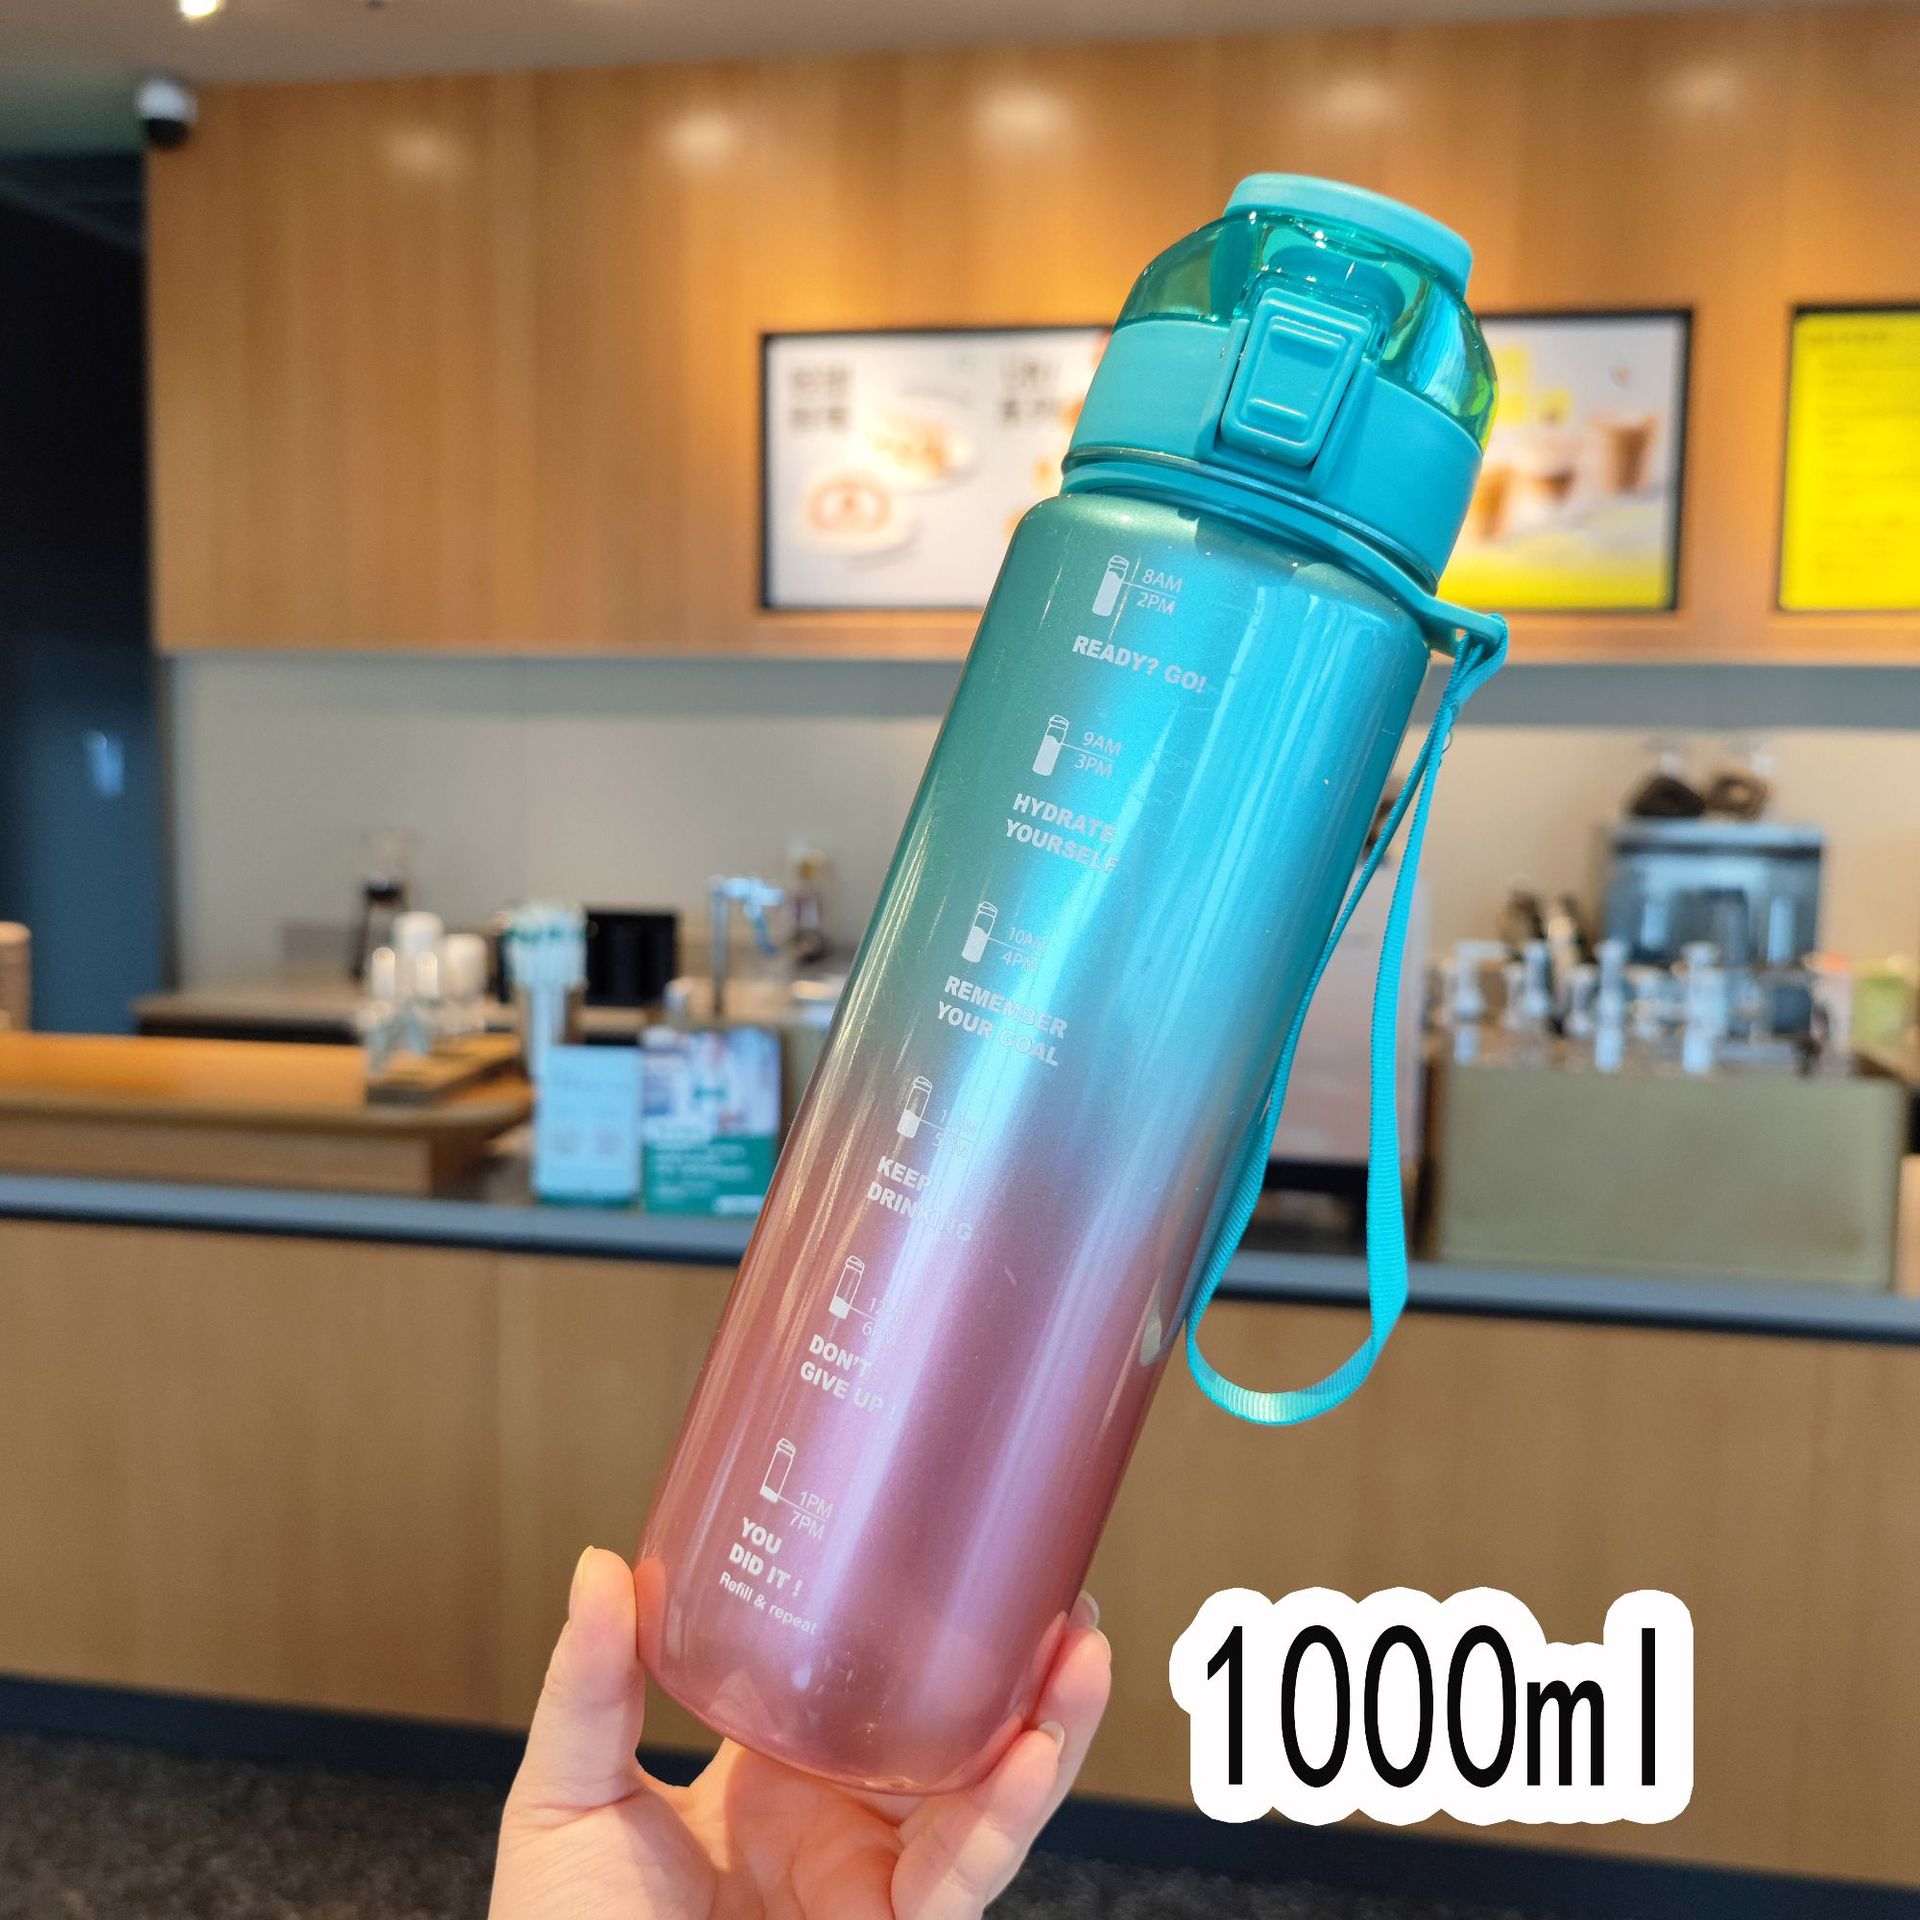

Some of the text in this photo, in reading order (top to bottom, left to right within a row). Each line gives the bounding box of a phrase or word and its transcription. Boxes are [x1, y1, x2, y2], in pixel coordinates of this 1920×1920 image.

[1136, 591, 1177, 616] 2PM
[1142, 568, 1183, 593] 8AM
[1072, 634, 1207, 693] READY? GO!
[1074, 753, 1114, 779] 3PM
[1082, 731, 1123, 756] 9AM
[1012, 792, 1118, 843] HYDRATE
[1006, 818, 1120, 874] YOURSELF
[944, 975, 1068, 1040] REMEMBER
[937, 1000, 1059, 1067] YOUR GOAL
[876, 1155, 932, 1191] KEEP
[867, 1181, 974, 1241] DRINKING
[808, 1334, 873, 1378] DON'T
[800, 1360, 850, 1399] GIVE
[853, 1387, 885, 1412] UP
[789, 1511, 825, 1540] 7PM
[800, 1490, 834, 1519] 1PM
[741, 1516, 782, 1555] YOU
[729, 1542, 764, 1576] DID
[766, 1566, 791, 1590] IT
[719, 1571, 818, 1636] Refill & repeat
